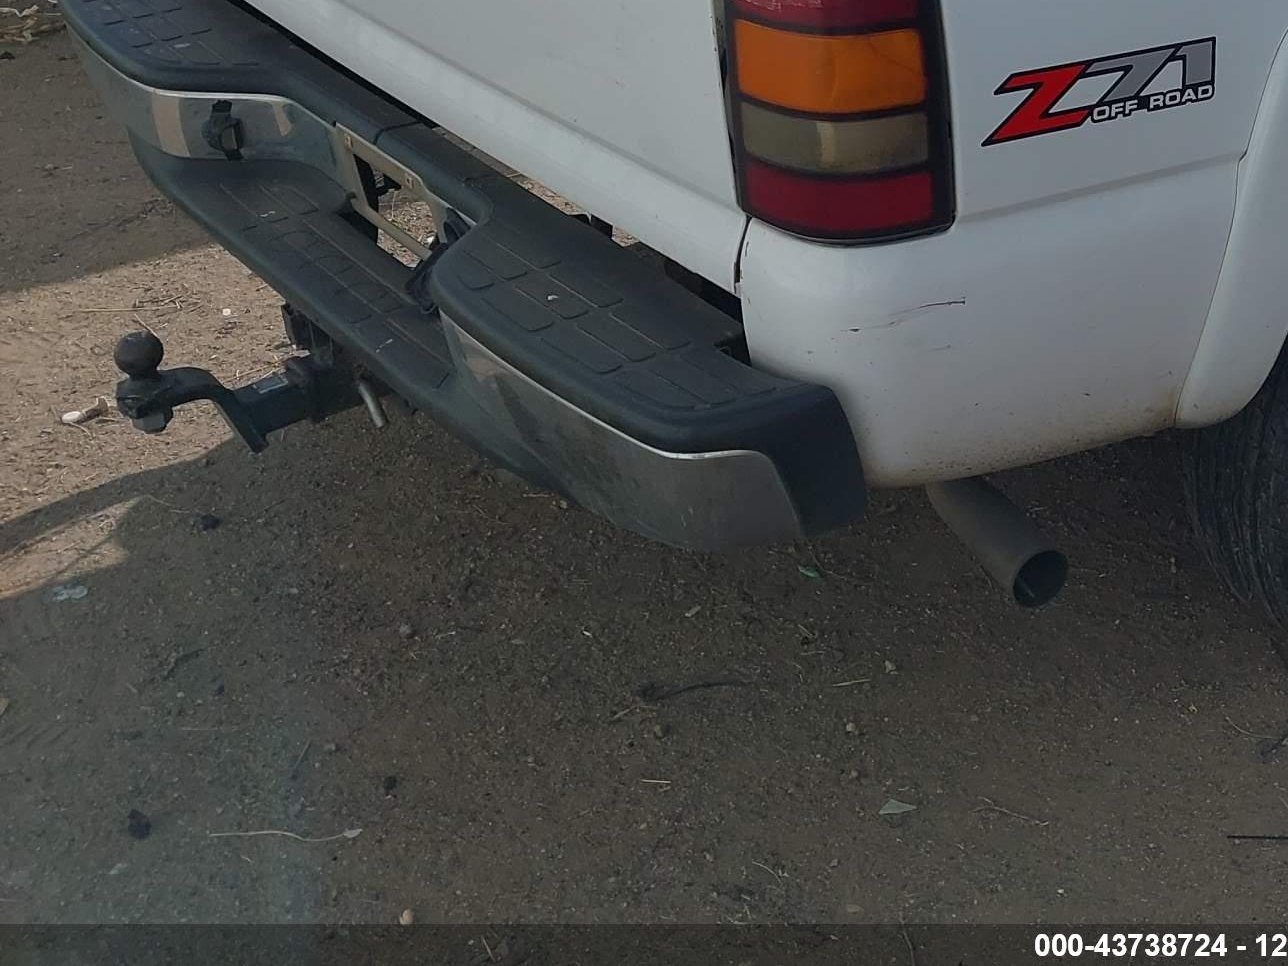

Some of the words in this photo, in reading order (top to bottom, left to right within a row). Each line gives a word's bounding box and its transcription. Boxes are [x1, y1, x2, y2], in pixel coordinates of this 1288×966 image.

[981, 36, 1216, 147] Z71
[1092, 99, 1138, 122] OFF
[1149, 85, 1214, 112] ROAD
